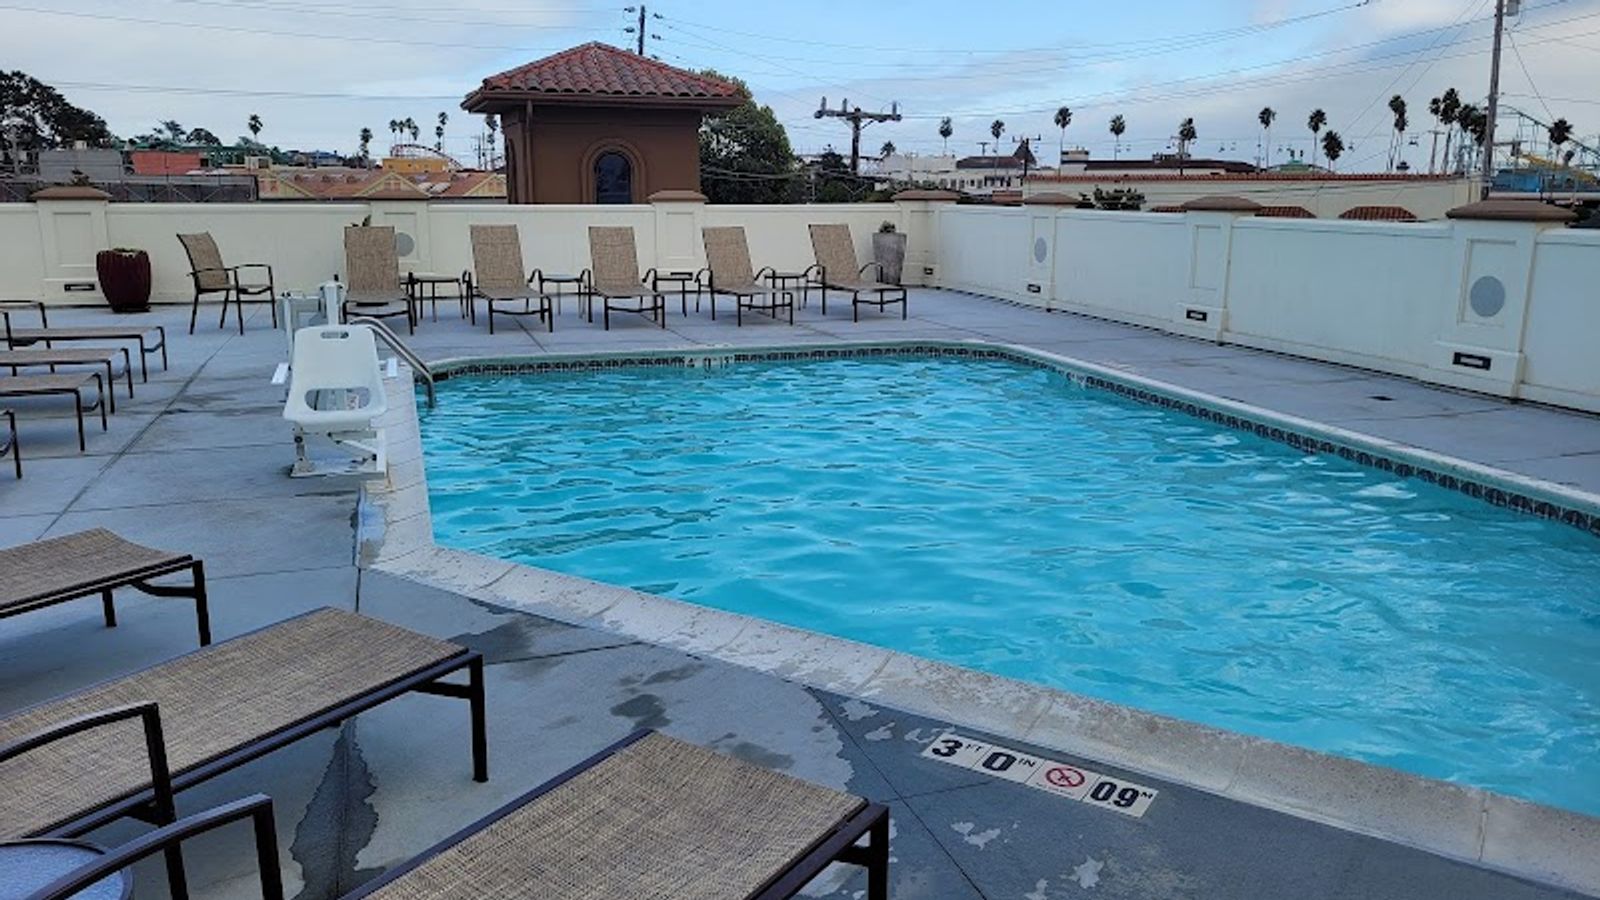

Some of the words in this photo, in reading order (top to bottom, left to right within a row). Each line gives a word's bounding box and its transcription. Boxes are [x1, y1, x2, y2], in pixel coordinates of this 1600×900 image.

[931, 739, 963, 757] 3
[982, 752, 1017, 771] 0
[1018, 757, 1036, 767] IN
